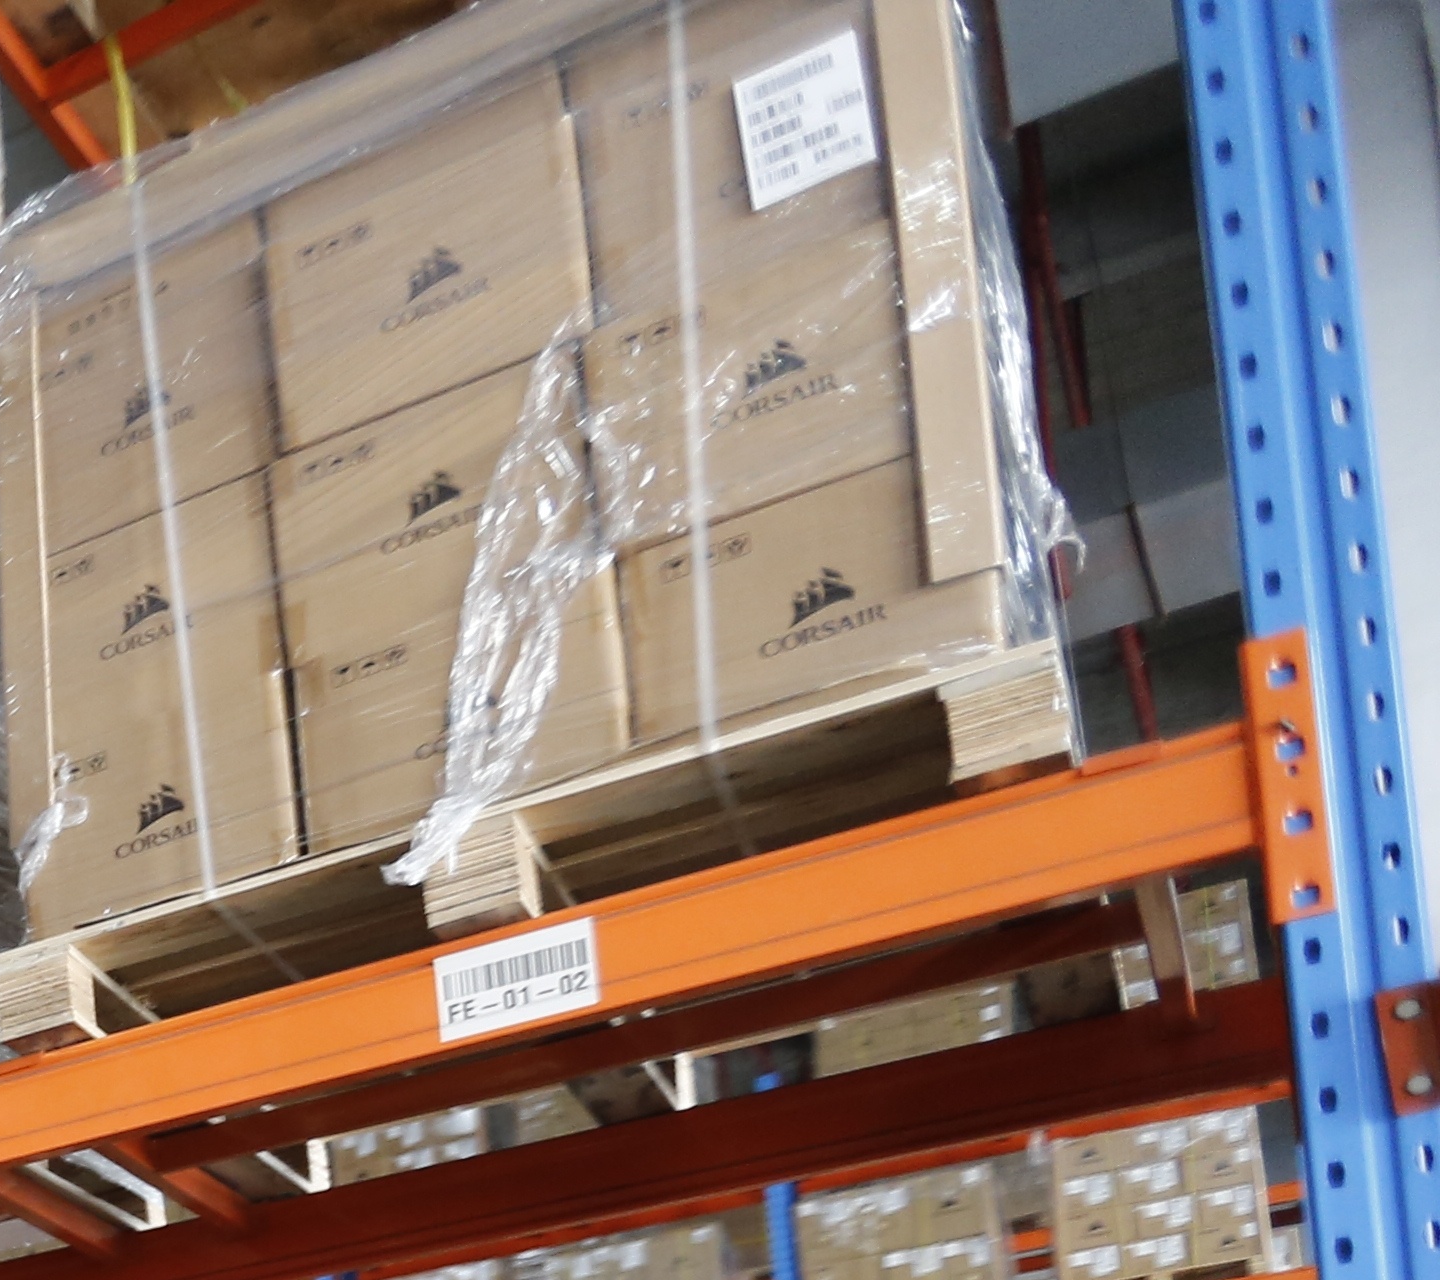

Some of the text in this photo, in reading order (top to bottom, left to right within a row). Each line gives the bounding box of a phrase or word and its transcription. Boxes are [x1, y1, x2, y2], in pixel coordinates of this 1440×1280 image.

[380, 277, 491, 334] CORSAIR
[712, 373, 840, 429] CORSAIR
[759, 603, 888, 659] CORSAIR
[115, 818, 199, 859] CORSAI
[447, 971, 588, 1024] FE-01-02
